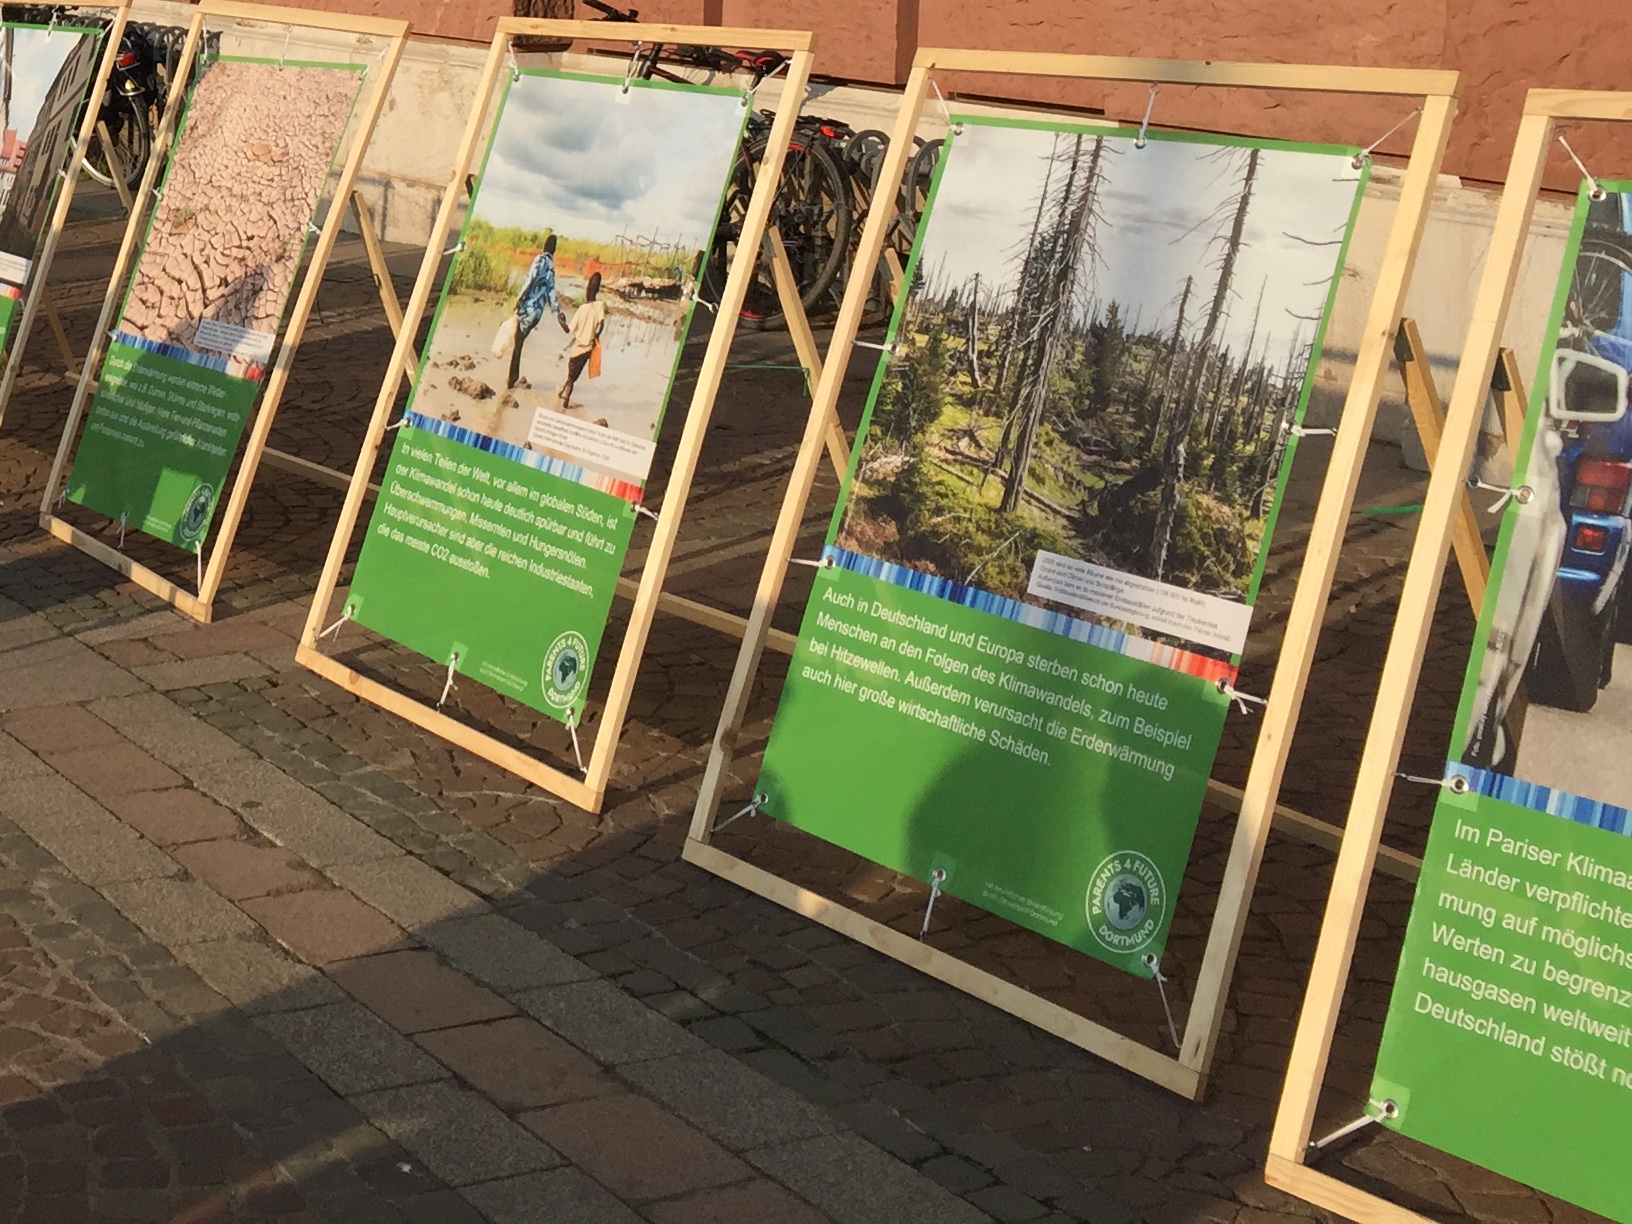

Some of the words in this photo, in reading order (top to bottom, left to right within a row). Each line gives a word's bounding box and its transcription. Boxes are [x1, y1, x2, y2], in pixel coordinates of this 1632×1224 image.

[395, 464, 410, 477] der
[408, 466, 458, 494] Klimawandel
[456, 486, 481, 504] schon
[479, 492, 504, 513] heute
[503, 502, 535, 524] deutlich
[534, 516, 568, 536] spürbar
[566, 528, 586, 543] und
[584, 530, 606, 551] führt
[603, 541, 617, 555] zu
[400, 441, 411, 456] In
[410, 447, 434, 464] vielen
[434, 452, 458, 472] Teilen
[456, 462, 473, 477] der
[492, 476, 507, 490] vor
[505, 480, 529, 498] allem
[528, 489, 541, 502] im
[538, 492, 575, 515] globalen
[606, 514, 619, 531] ist
[468, 511, 512, 540] Missernten
[511, 531, 530, 546] und
[377, 522, 391, 538] die
[390, 527, 405, 543] das
[404, 535, 431, 554] meiste
[430, 543, 450, 562] CO2
[448, 553, 490, 579] ausstoßen.
[382, 501, 450, 538] Hauptverursacher
[448, 529, 467, 545] sind
[464, 536, 485, 552] aber
[483, 542, 498, 558] die
[497, 549, 529, 570] reichen
[816, 610, 879, 646] Menschen
[879, 635, 897, 652] an
[898, 640, 923, 660] den
[924, 647, 969, 676] Folgen
[970, 664, 997, 685] des
[998, 671, 1094, 721] Klimawandels,
[1097, 708, 1131, 730] zum
[1132, 716, 1193, 751] Beispiel
[822, 586, 855, 609] Auch
[856, 596, 869, 614] in
[870, 600, 949, 640] Deutschland
[949, 629, 976, 649] und
[976, 634, 1025, 665] Europa
[1026, 654, 1079, 682] sterben
[1080, 672, 1124, 697] schon
[1126, 682, 1169, 711] heute
[801, 665, 832, 686] auch
[833, 673, 859, 695] hier
[857, 685, 896, 709] große
[898, 699, 987, 742] wirtschaftliche
[988, 729, 1051, 766] Schäden.
[808, 636, 830, 657] bei
[829, 643, 901, 683] Hitzewellen.
[904, 670, 972, 706] Außerdem
[974, 696, 1044, 732] verursacht
[1045, 719, 1068, 740] die
[1069, 726, 1176, 782] Erderwärmung
[1092, 859, 1122, 914] PARENTS
[1124, 858, 1131, 870] 4
[1133, 859, 1160, 905] FUTURE
[1455, 819, 1480, 843] Im
[1486, 828, 1562, 867] Pariser
[1098, 919, 1155, 947] DORTMUND
[1438, 892, 1496, 928] mung
[1502, 913, 1538, 937] auf
[1541, 926, 1632, 969] möglichs
[1447, 853, 1520, 892] Länder
[1525, 881, 1632, 929] verpflichte
[1422, 957, 1536, 1014] hausgasen
[1543, 1002, 1631, 1048] weltweit
[1432, 922, 1505, 964] Werten
[1510, 954, 1536, 975] zu
[1543, 960, 1632, 1009] begrenz
[1414, 992, 1545, 1056] Deutschland
[1551, 1045, 1607, 1080] stößt
